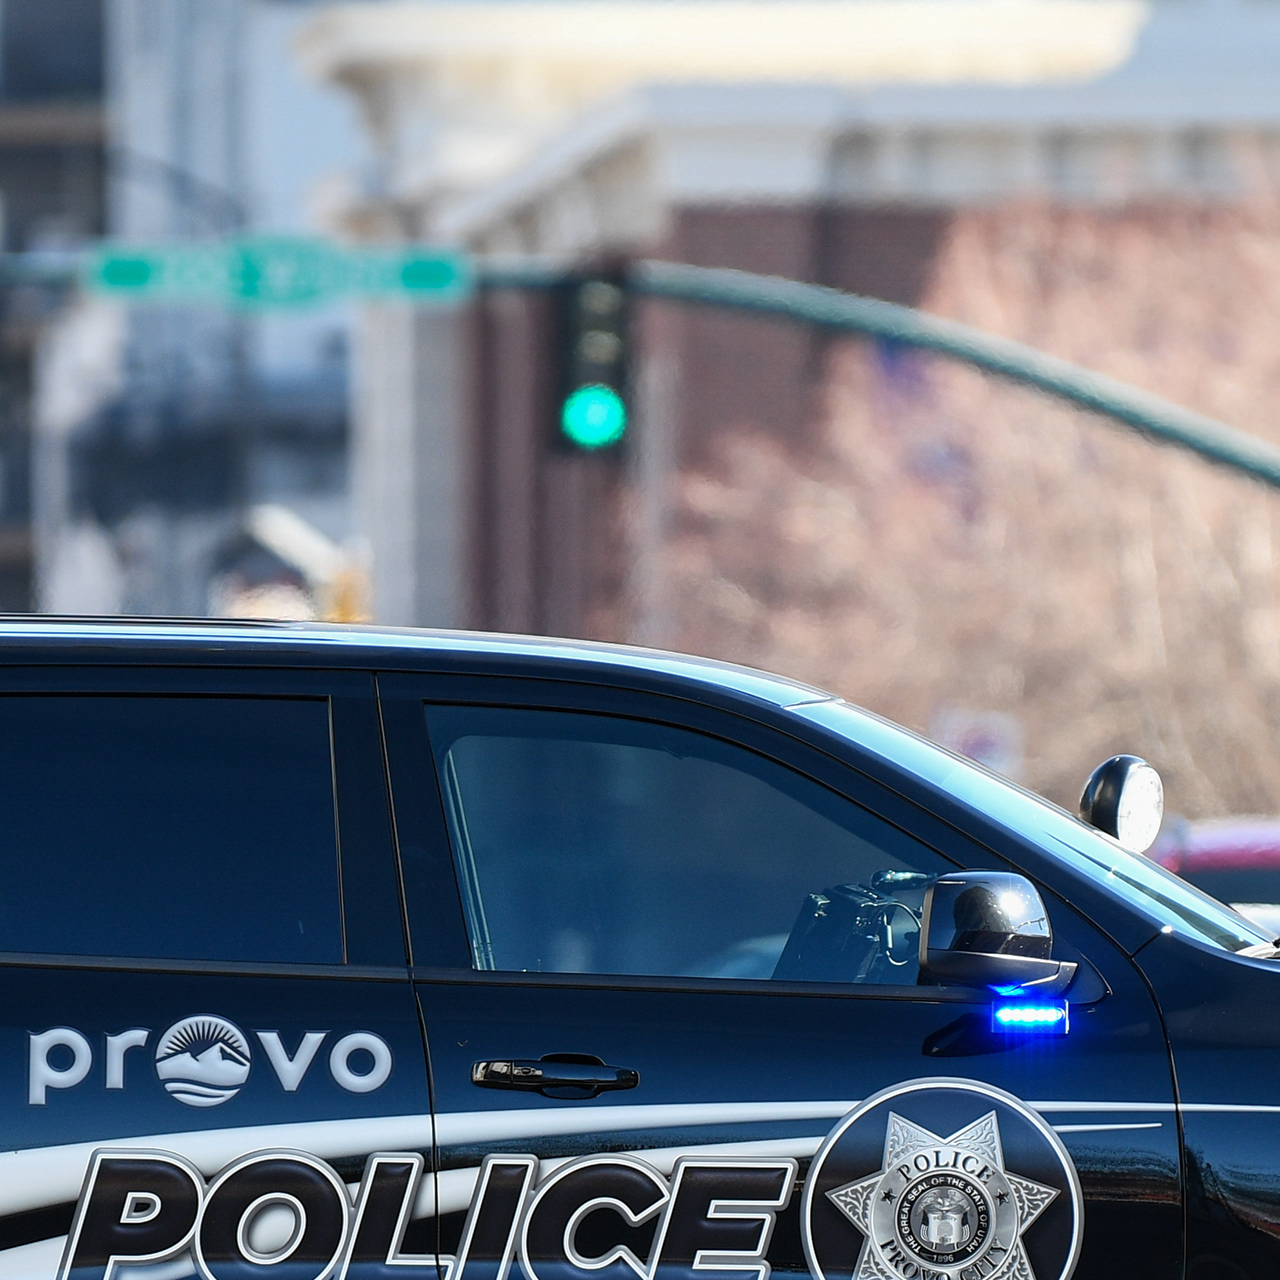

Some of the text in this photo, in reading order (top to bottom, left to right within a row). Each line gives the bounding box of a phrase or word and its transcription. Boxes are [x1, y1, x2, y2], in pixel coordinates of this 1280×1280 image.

[27, 1012, 393, 1107] provo
[897, 1150, 996, 1184] POLICE
[907, 1181, 930, 1201] SEAL
[931, 1177, 946, 1186] OF
[946, 1176, 966, 1189] THE
[965, 1186, 987, 1213] STATE
[900, 1201, 912, 1234] GREAT
[979, 1214, 988, 1228] OF
[905, 1235, 922, 1254] THE
[966, 1230, 986, 1253] UTAH
[932, 1254, 955, 1262] 1896
